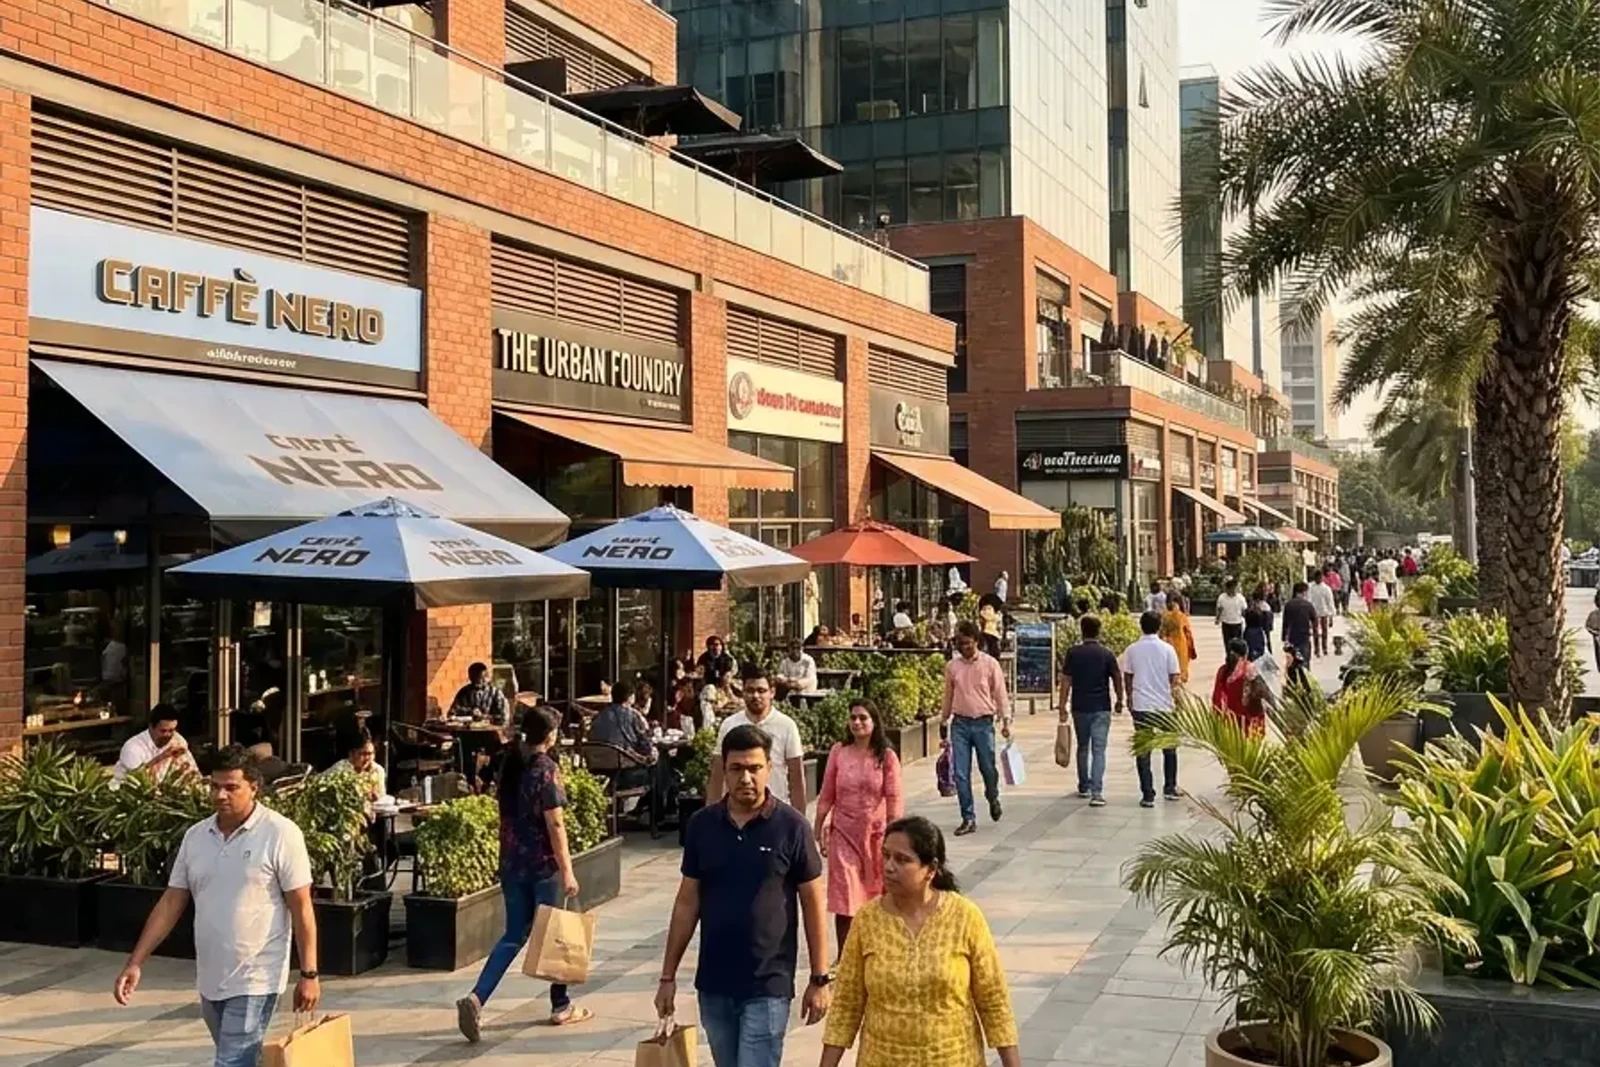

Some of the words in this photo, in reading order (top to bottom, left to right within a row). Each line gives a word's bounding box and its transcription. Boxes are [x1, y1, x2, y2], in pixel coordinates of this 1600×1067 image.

[98, 257, 261, 325] CAFFÈ
[267, 288, 385, 346] NERO
[497, 327, 540, 375] THE
[542, 336, 607, 386] URBAN
[610, 350, 685, 397] FOUNDRY
[248, 454, 444, 492] NERO
[428, 549, 523, 566] NERO
[582, 545, 675, 561] NERO
